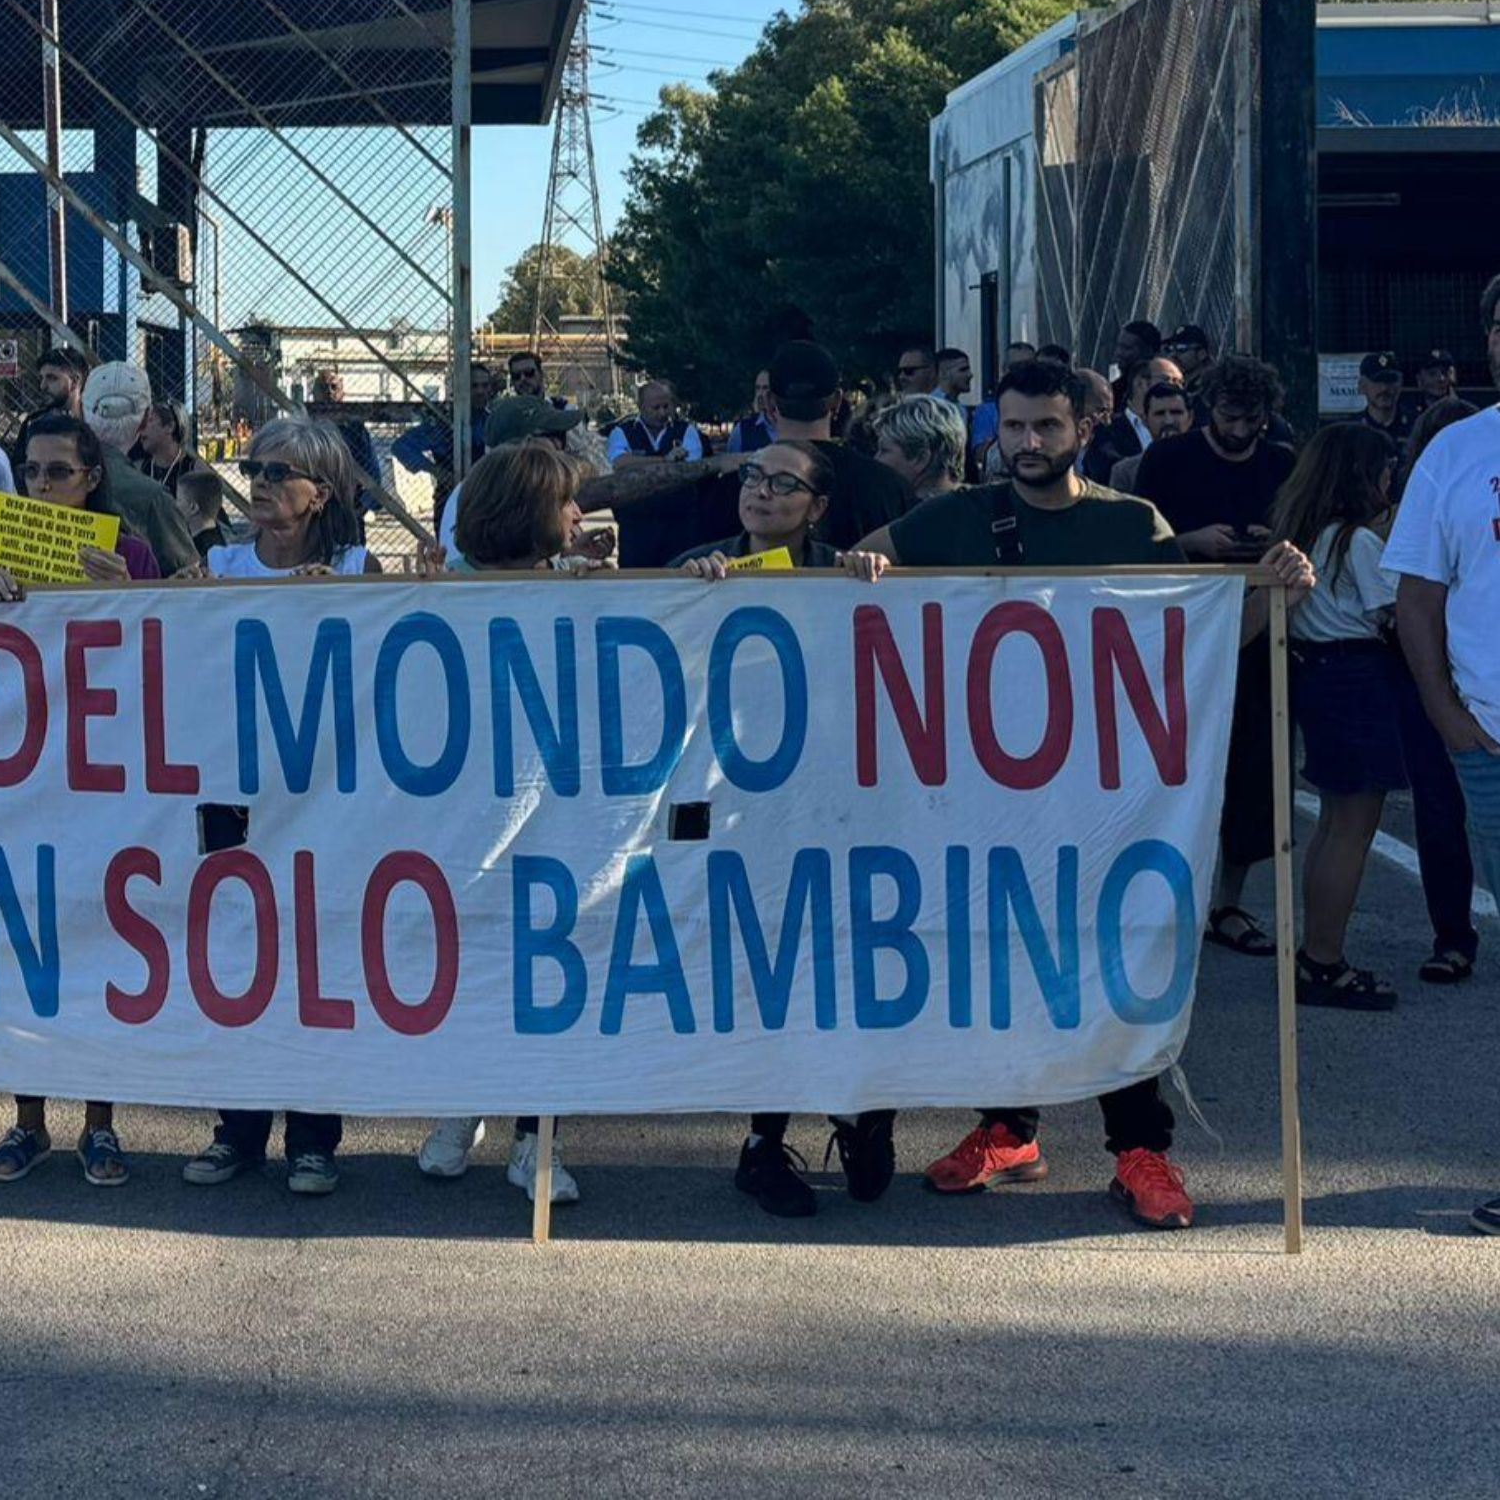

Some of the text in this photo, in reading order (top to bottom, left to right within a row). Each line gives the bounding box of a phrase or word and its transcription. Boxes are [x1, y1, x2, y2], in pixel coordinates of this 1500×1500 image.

[234, 606, 809, 798] MONDO
[852, 600, 1188, 791] NON
[104, 845, 460, 1036] SOLO
[511, 837, 1197, 1035] BAMBINO
